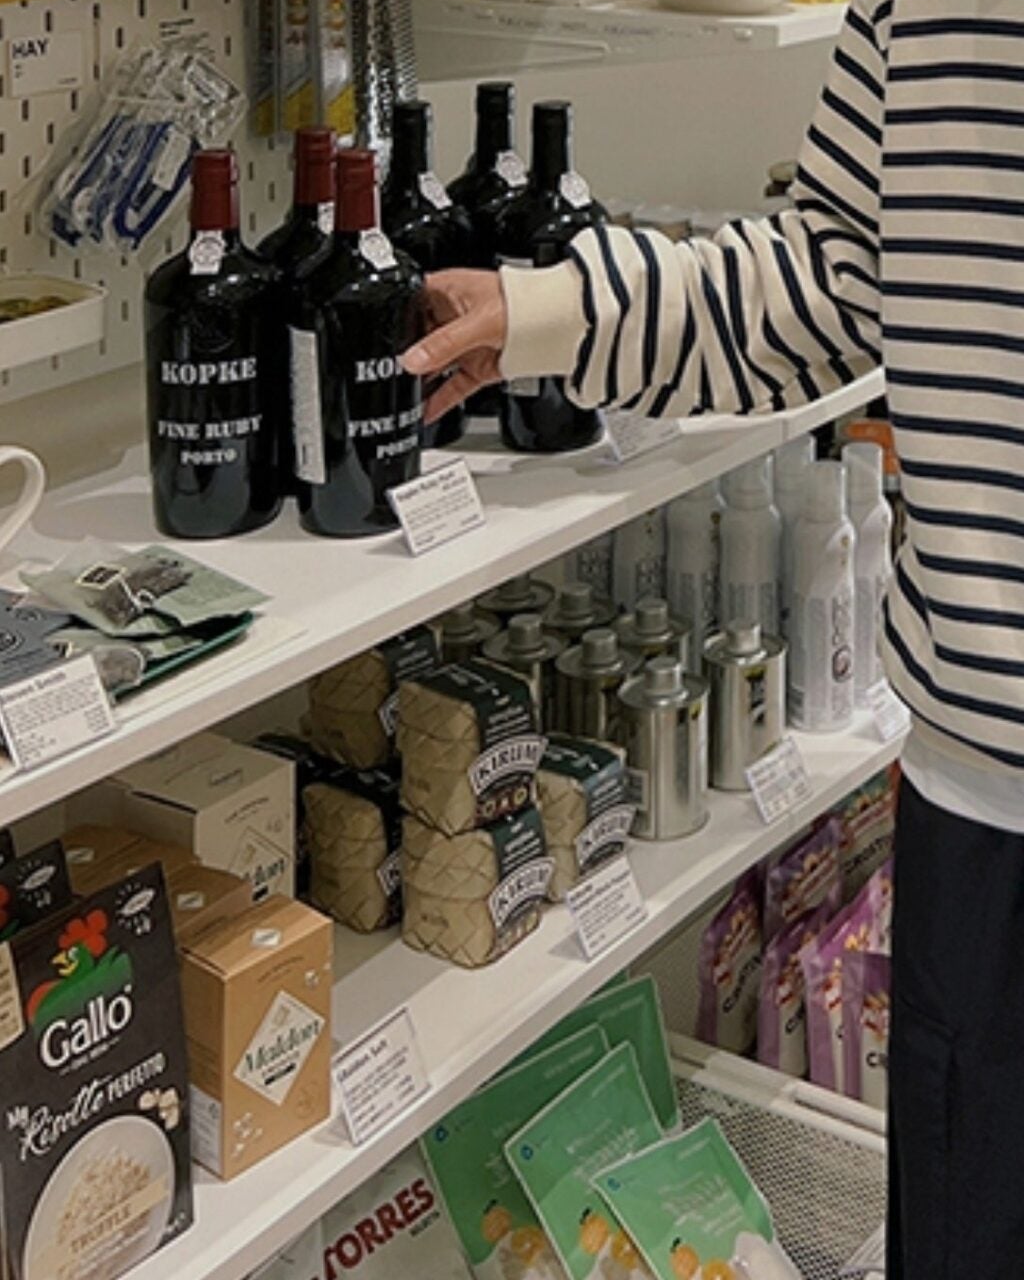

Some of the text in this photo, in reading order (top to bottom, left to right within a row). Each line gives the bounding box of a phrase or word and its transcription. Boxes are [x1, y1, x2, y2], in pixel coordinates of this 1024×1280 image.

[12, 38, 49, 58] HAY
[161, 356, 257, 386] KOPKE
[158, 414, 263, 440] FINE RUBY
[347, 414, 395, 438] FINE
[40, 995, 133, 1068] Gallo
